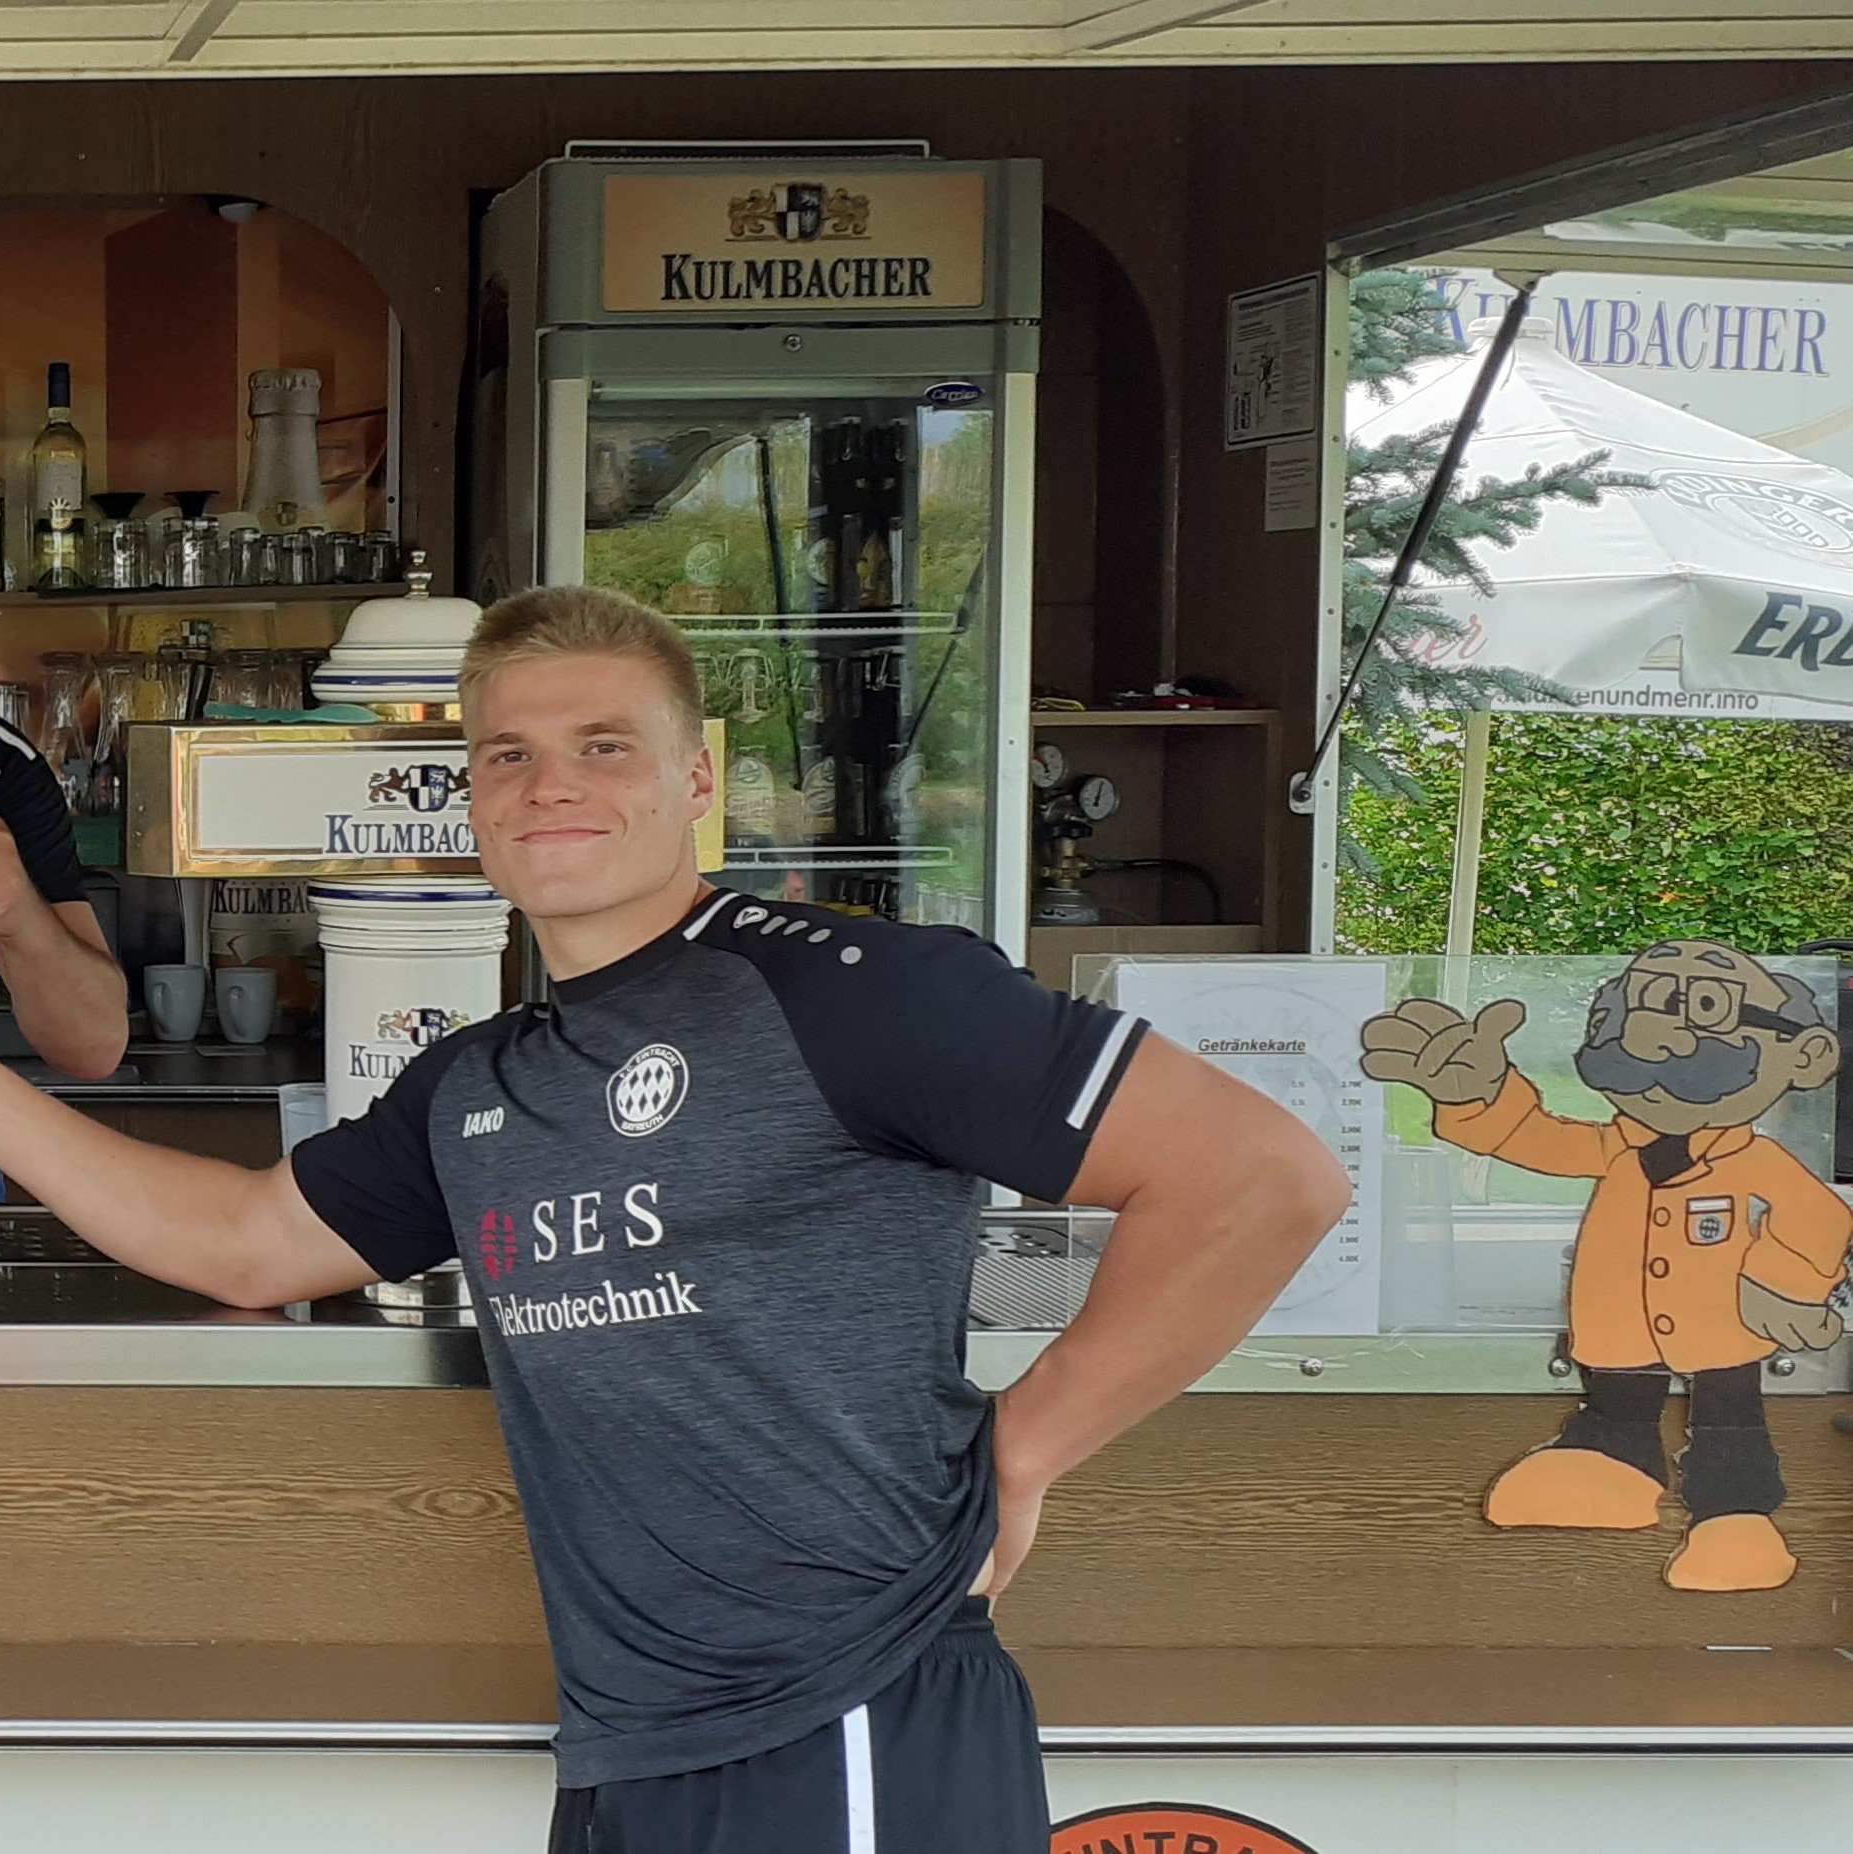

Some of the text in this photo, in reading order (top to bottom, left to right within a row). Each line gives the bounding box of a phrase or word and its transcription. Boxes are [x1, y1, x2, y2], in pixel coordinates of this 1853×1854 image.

[660, 253, 932, 301] KULMBACHER
[1433, 277, 1830, 378] KMBACHER
[325, 814, 480, 853] KULMBAC
[1198, 1038, 1306, 1052] Getränkekarte
[462, 1106, 505, 1139] JAKO
[533, 1182, 664, 1263] SES
[488, 1271, 703, 1337] Elektrotechnik
